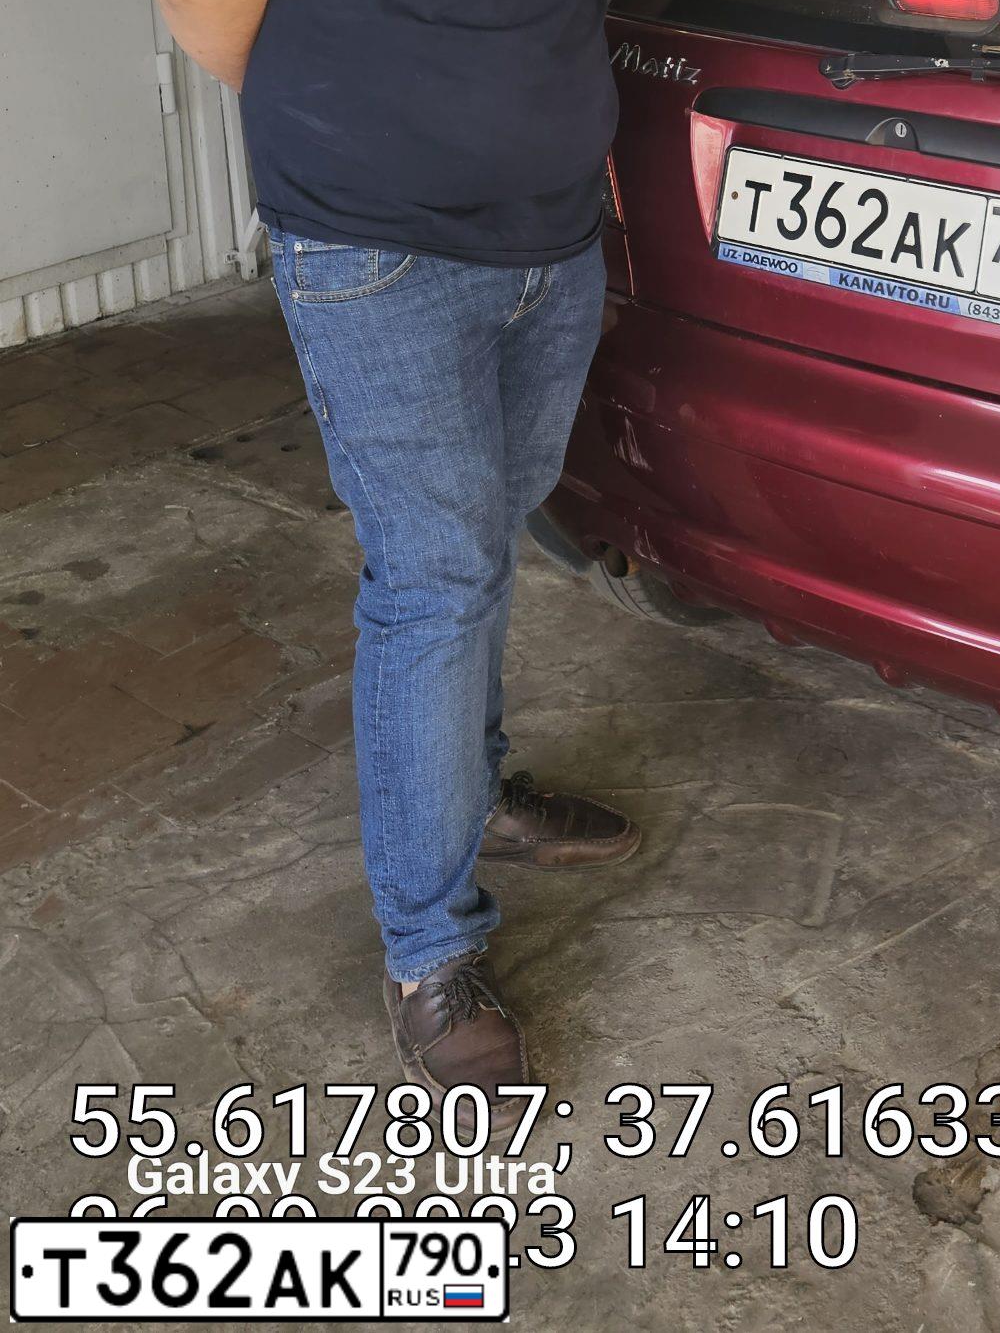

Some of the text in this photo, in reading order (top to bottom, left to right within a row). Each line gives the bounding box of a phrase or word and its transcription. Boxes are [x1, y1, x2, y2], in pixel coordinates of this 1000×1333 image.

[609, 41, 702, 85] Matiz
[721, 246, 799, 274] UZ-DAEWOO
[838, 272, 951, 310] KANAVTO.RU
